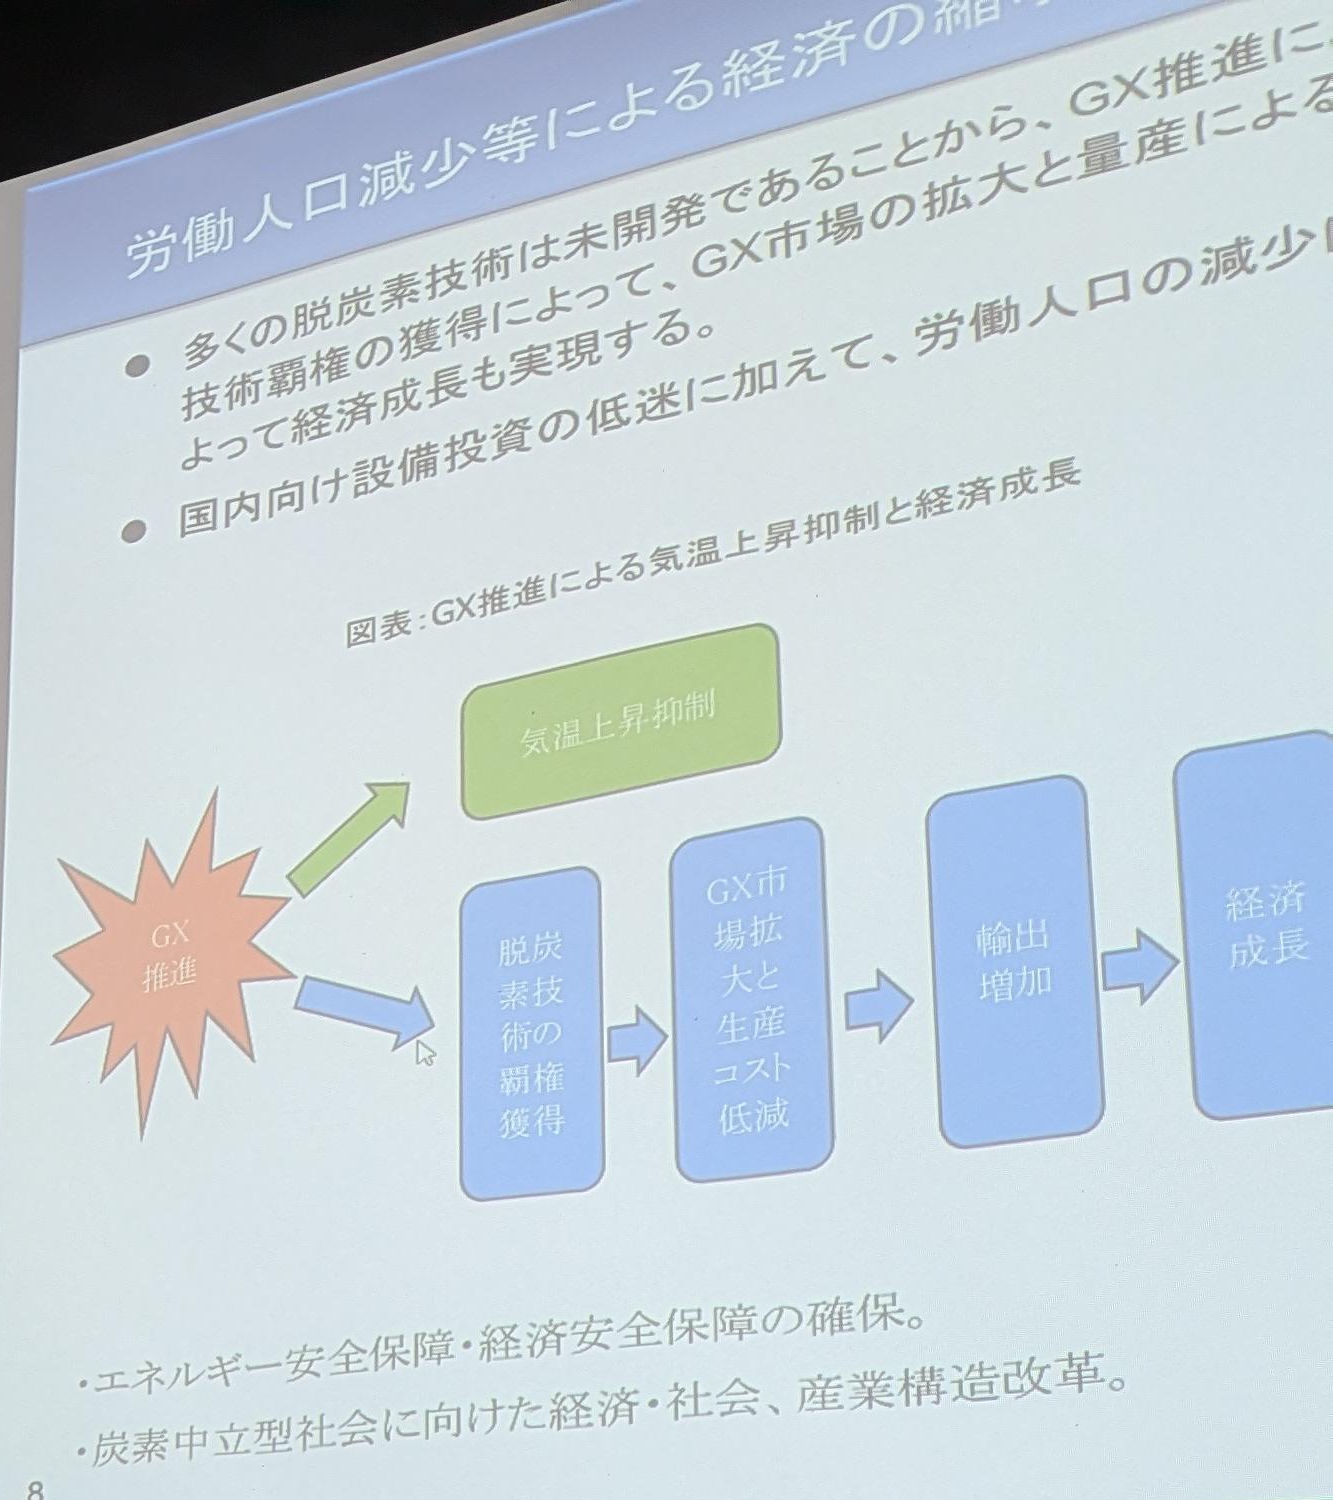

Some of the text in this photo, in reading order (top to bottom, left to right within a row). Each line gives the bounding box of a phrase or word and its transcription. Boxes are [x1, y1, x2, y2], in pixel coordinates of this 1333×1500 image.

[126, 0, 1050, 281] 労働人口減少等による経済の縮
[183, 20, 1333, 372] 多くの脱炭素技術は未開発であることから、GX推進に
[179, 216, 1333, 539] 国内向け設備投資の低迷に加えて、労働人口の減少
[181, 307, 714, 471] よって経済成長も実現する。
[520, 688, 717, 759] 気温上昇抑制
[707, 864, 789, 907] GX市
[1225, 879, 1306, 924] 経済
[151, 921, 191, 949] GX
[498, 932, 563, 969] 脱炭
[713, 913, 783, 954] 場拡
[976, 919, 1049, 957] 輸出
[1229, 927, 1311, 971] 成長
[142, 959, 199, 995] 推進
[498, 975, 564, 1012] 素技
[721, 964, 780, 998] 大と
[979, 965, 1052, 1003] 増加
[500, 1018, 562, 1052] 術の
[717, 1005, 786, 1047] 生産
[498, 1061, 565, 1096] 覇権
[714, 1056, 792, 1088] コスト
[498, 1104, 566, 1140] 獲得
[719, 1095, 791, 1137] 低減
